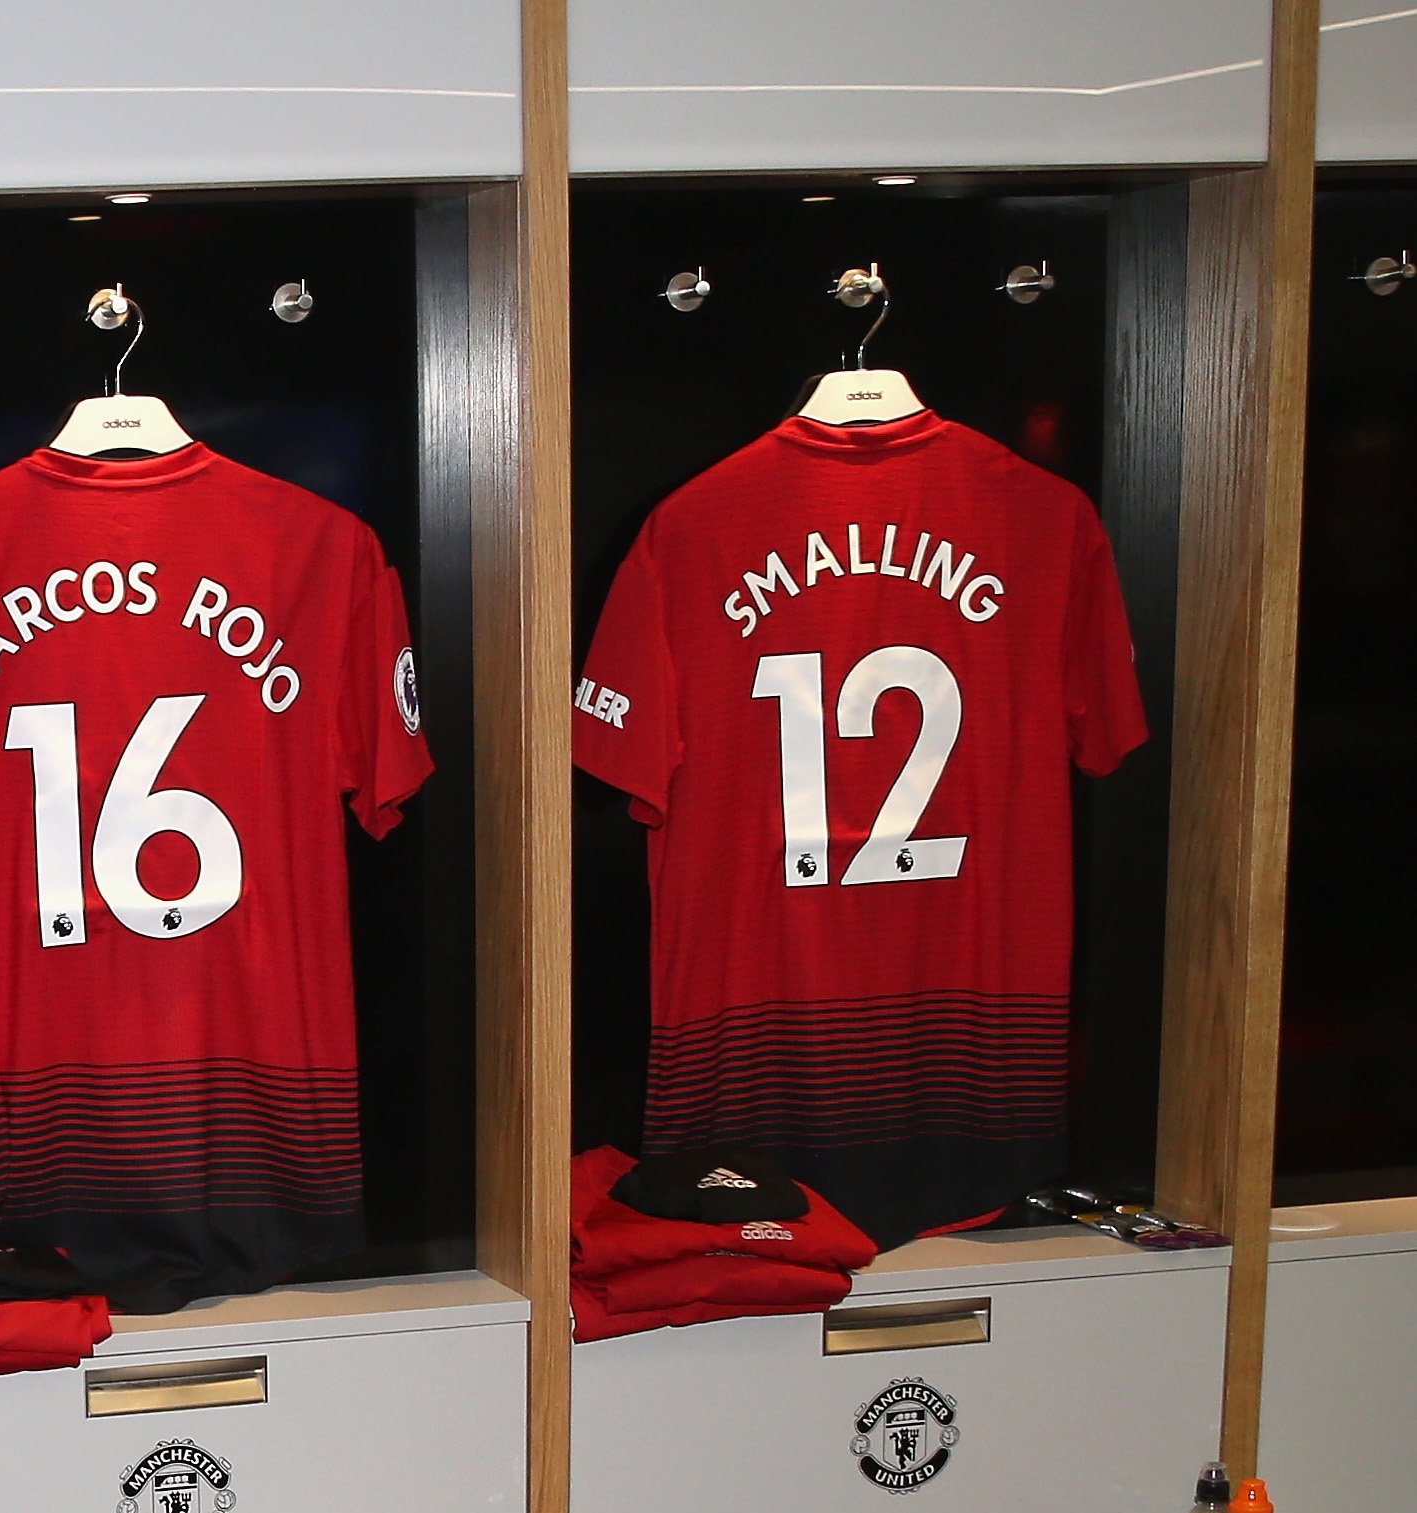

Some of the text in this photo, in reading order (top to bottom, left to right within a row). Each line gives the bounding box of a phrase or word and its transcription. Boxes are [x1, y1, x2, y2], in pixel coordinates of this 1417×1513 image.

[725, 523, 1004, 638] SMALLING
[181, 577, 300, 713] ROJO
[751, 645, 968, 887] 12
[4, 694, 242, 948] 16
[740, 1229, 793, 1240] adidas
[862, 1387, 948, 1427] MANCHESTER
[128, 1448, 223, 1490] MANCHESTER
[875, 1464, 934, 1486] UNITED
